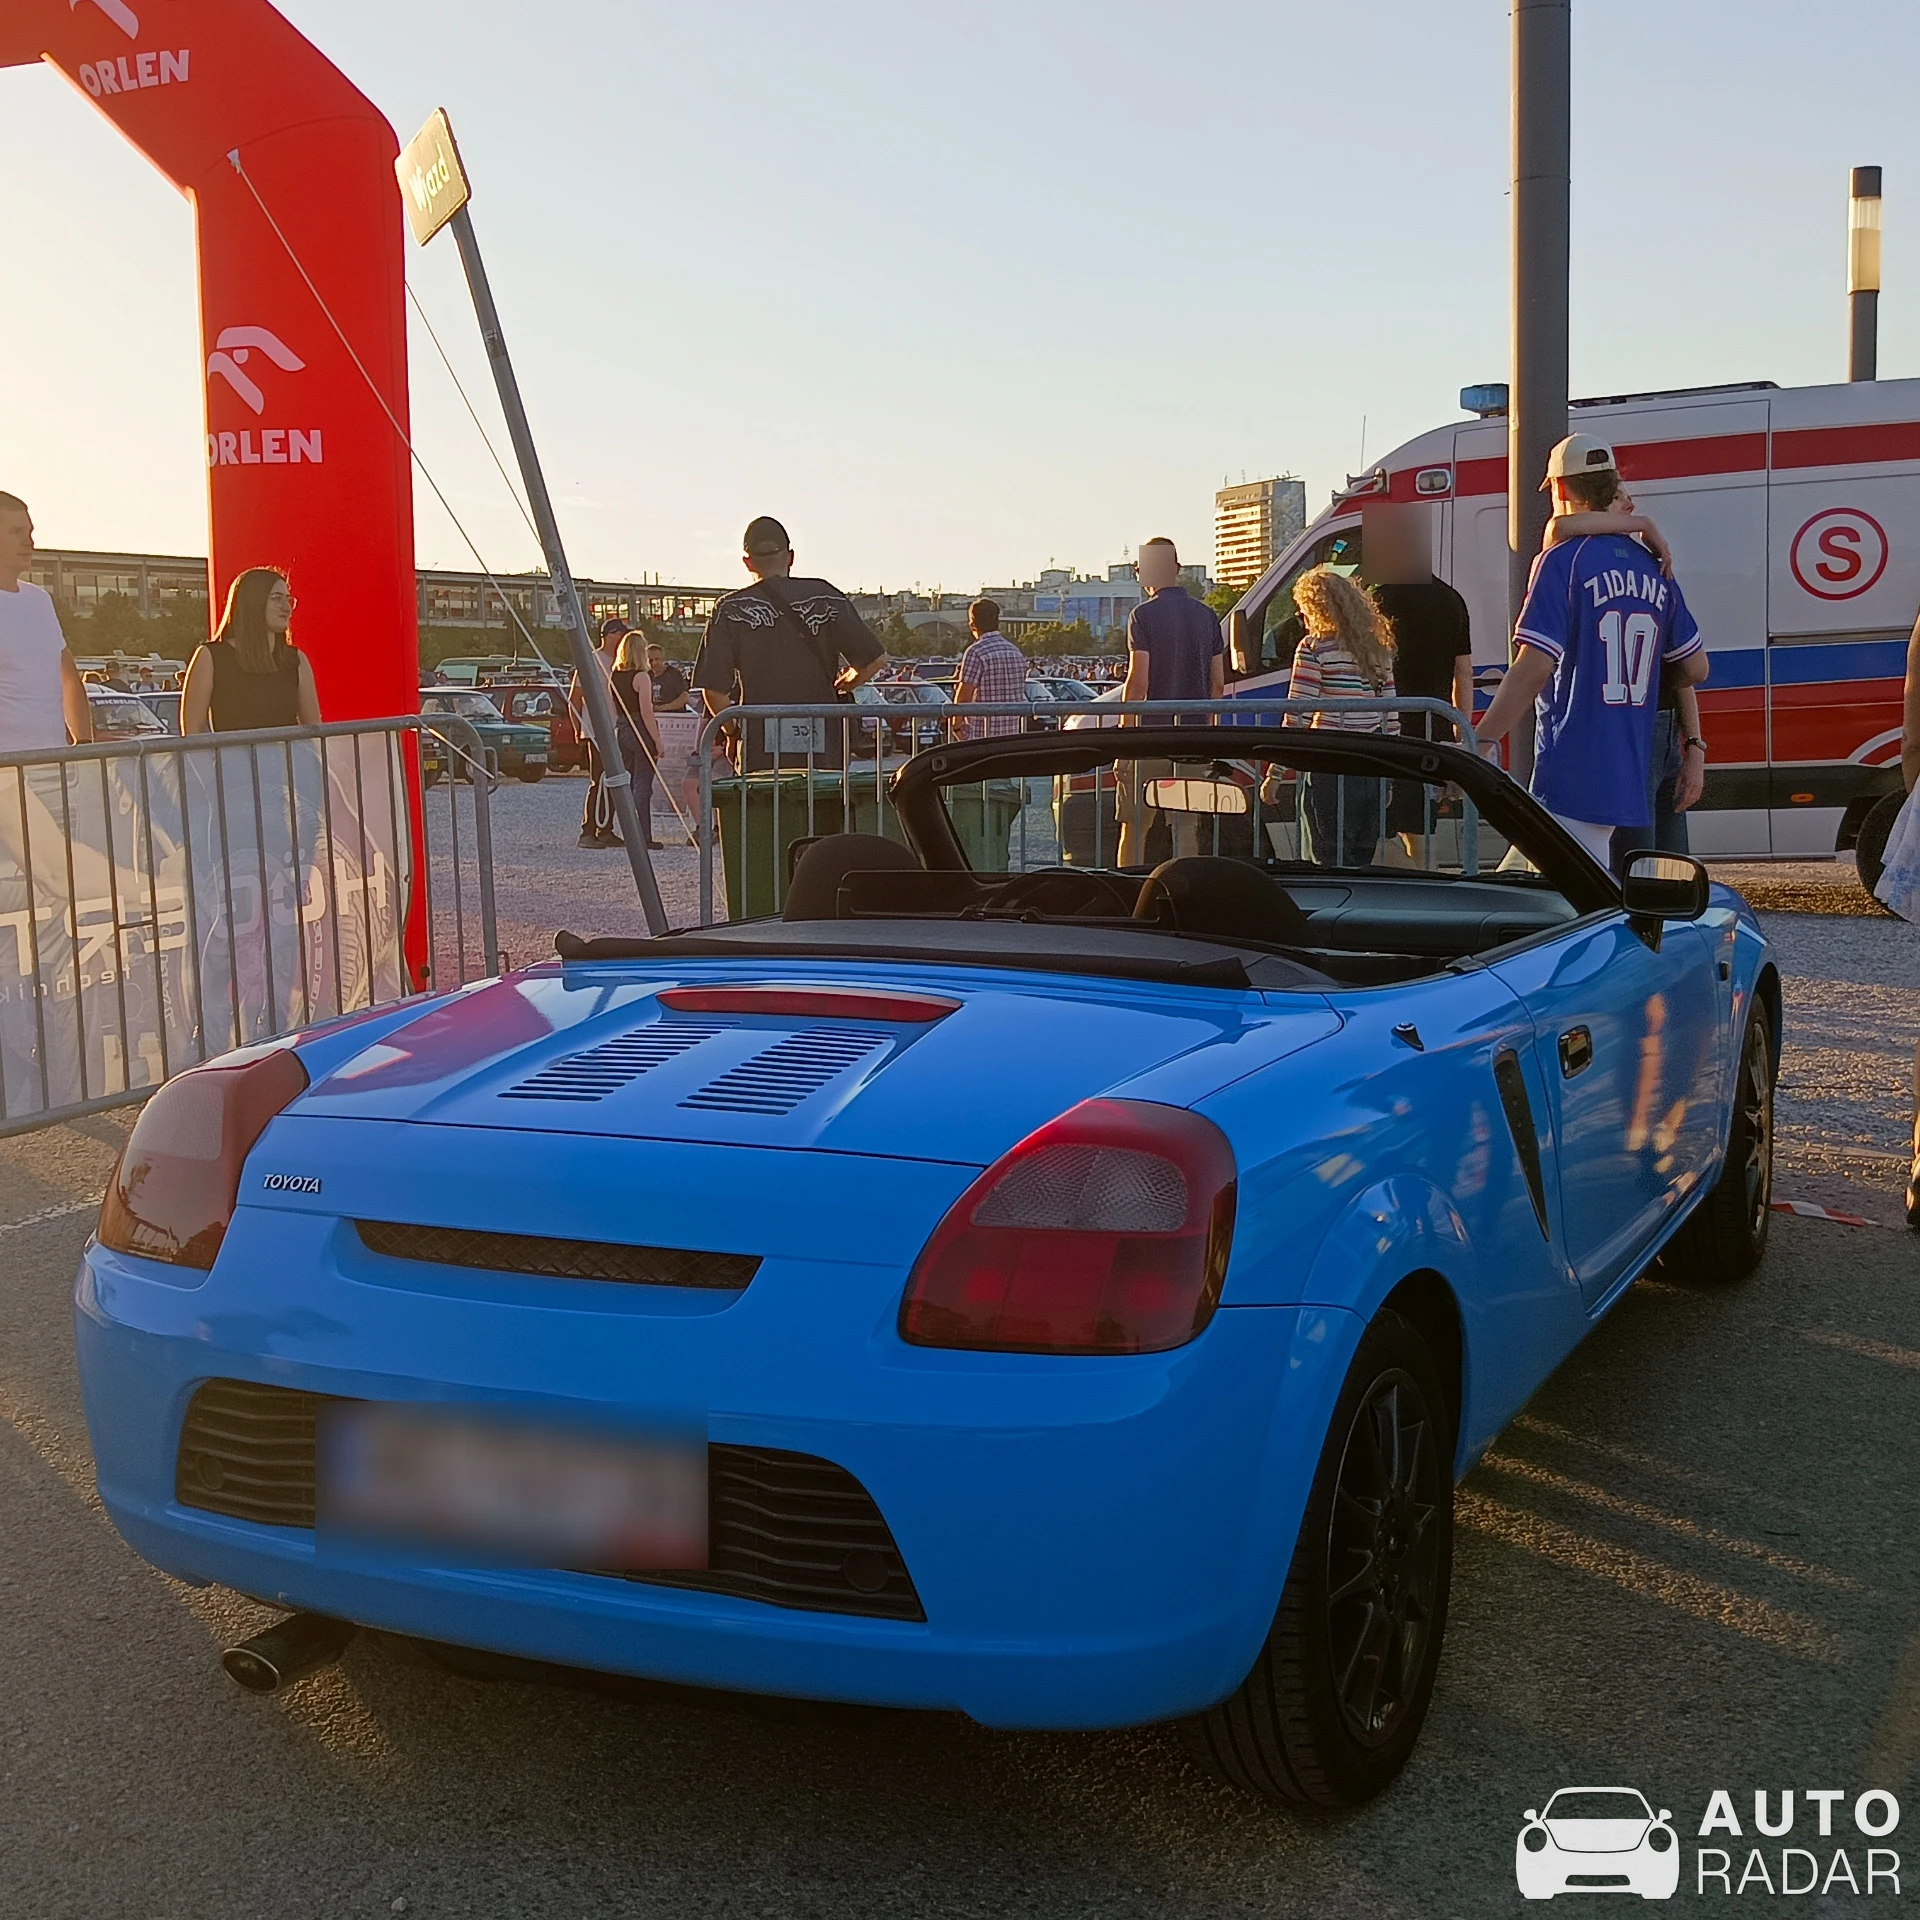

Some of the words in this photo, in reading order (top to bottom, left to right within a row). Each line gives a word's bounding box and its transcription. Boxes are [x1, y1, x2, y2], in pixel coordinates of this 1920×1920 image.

[79, 49, 190, 97] ORLEN
[1815, 526, 1862, 581] S
[1583, 569, 1668, 612] ZIDANE
[1598, 610, 1659, 706] 10
[263, 1173, 321, 1193] TOYOTA
